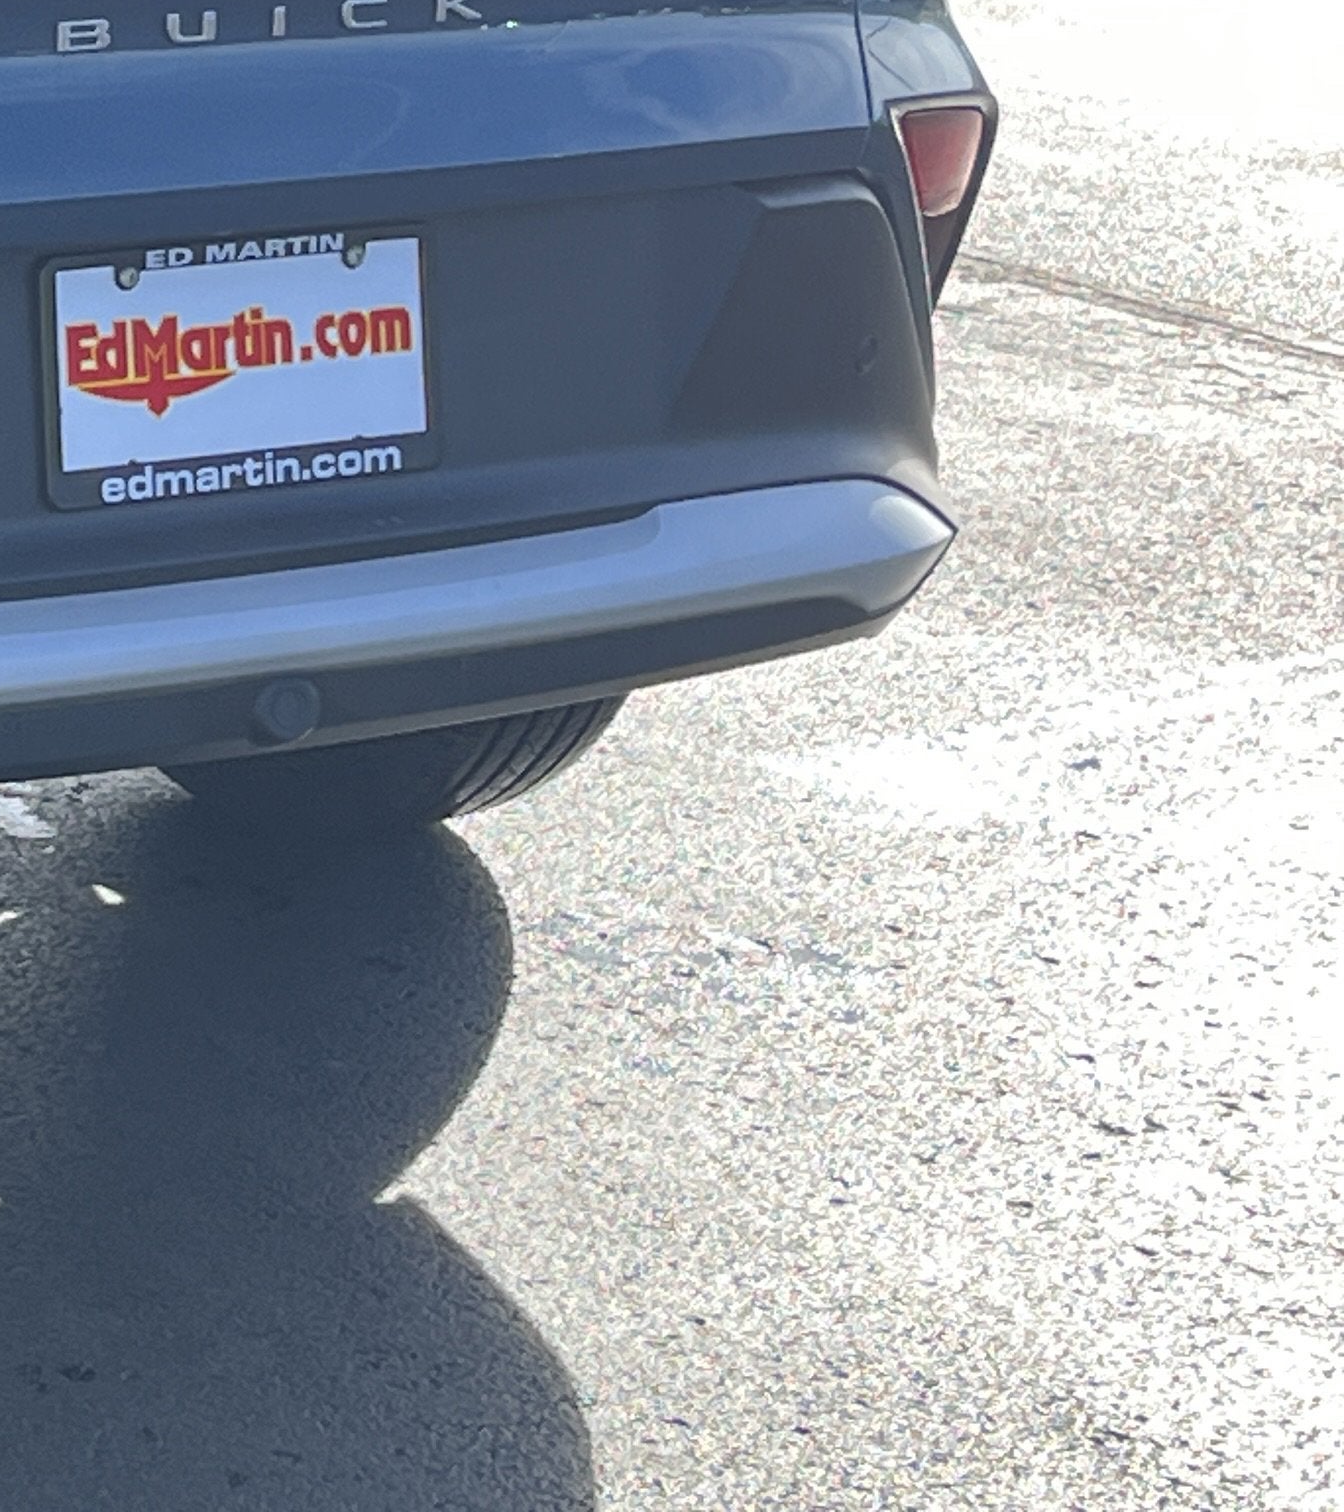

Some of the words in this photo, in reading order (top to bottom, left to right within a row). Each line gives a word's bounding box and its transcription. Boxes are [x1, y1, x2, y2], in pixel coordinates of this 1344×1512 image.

[144, 248, 194, 269] ED
[205, 233, 345, 263] MARTIN
[65, 306, 413, 388] EdMartin.com
[99, 443, 403, 506] edmartin.com
